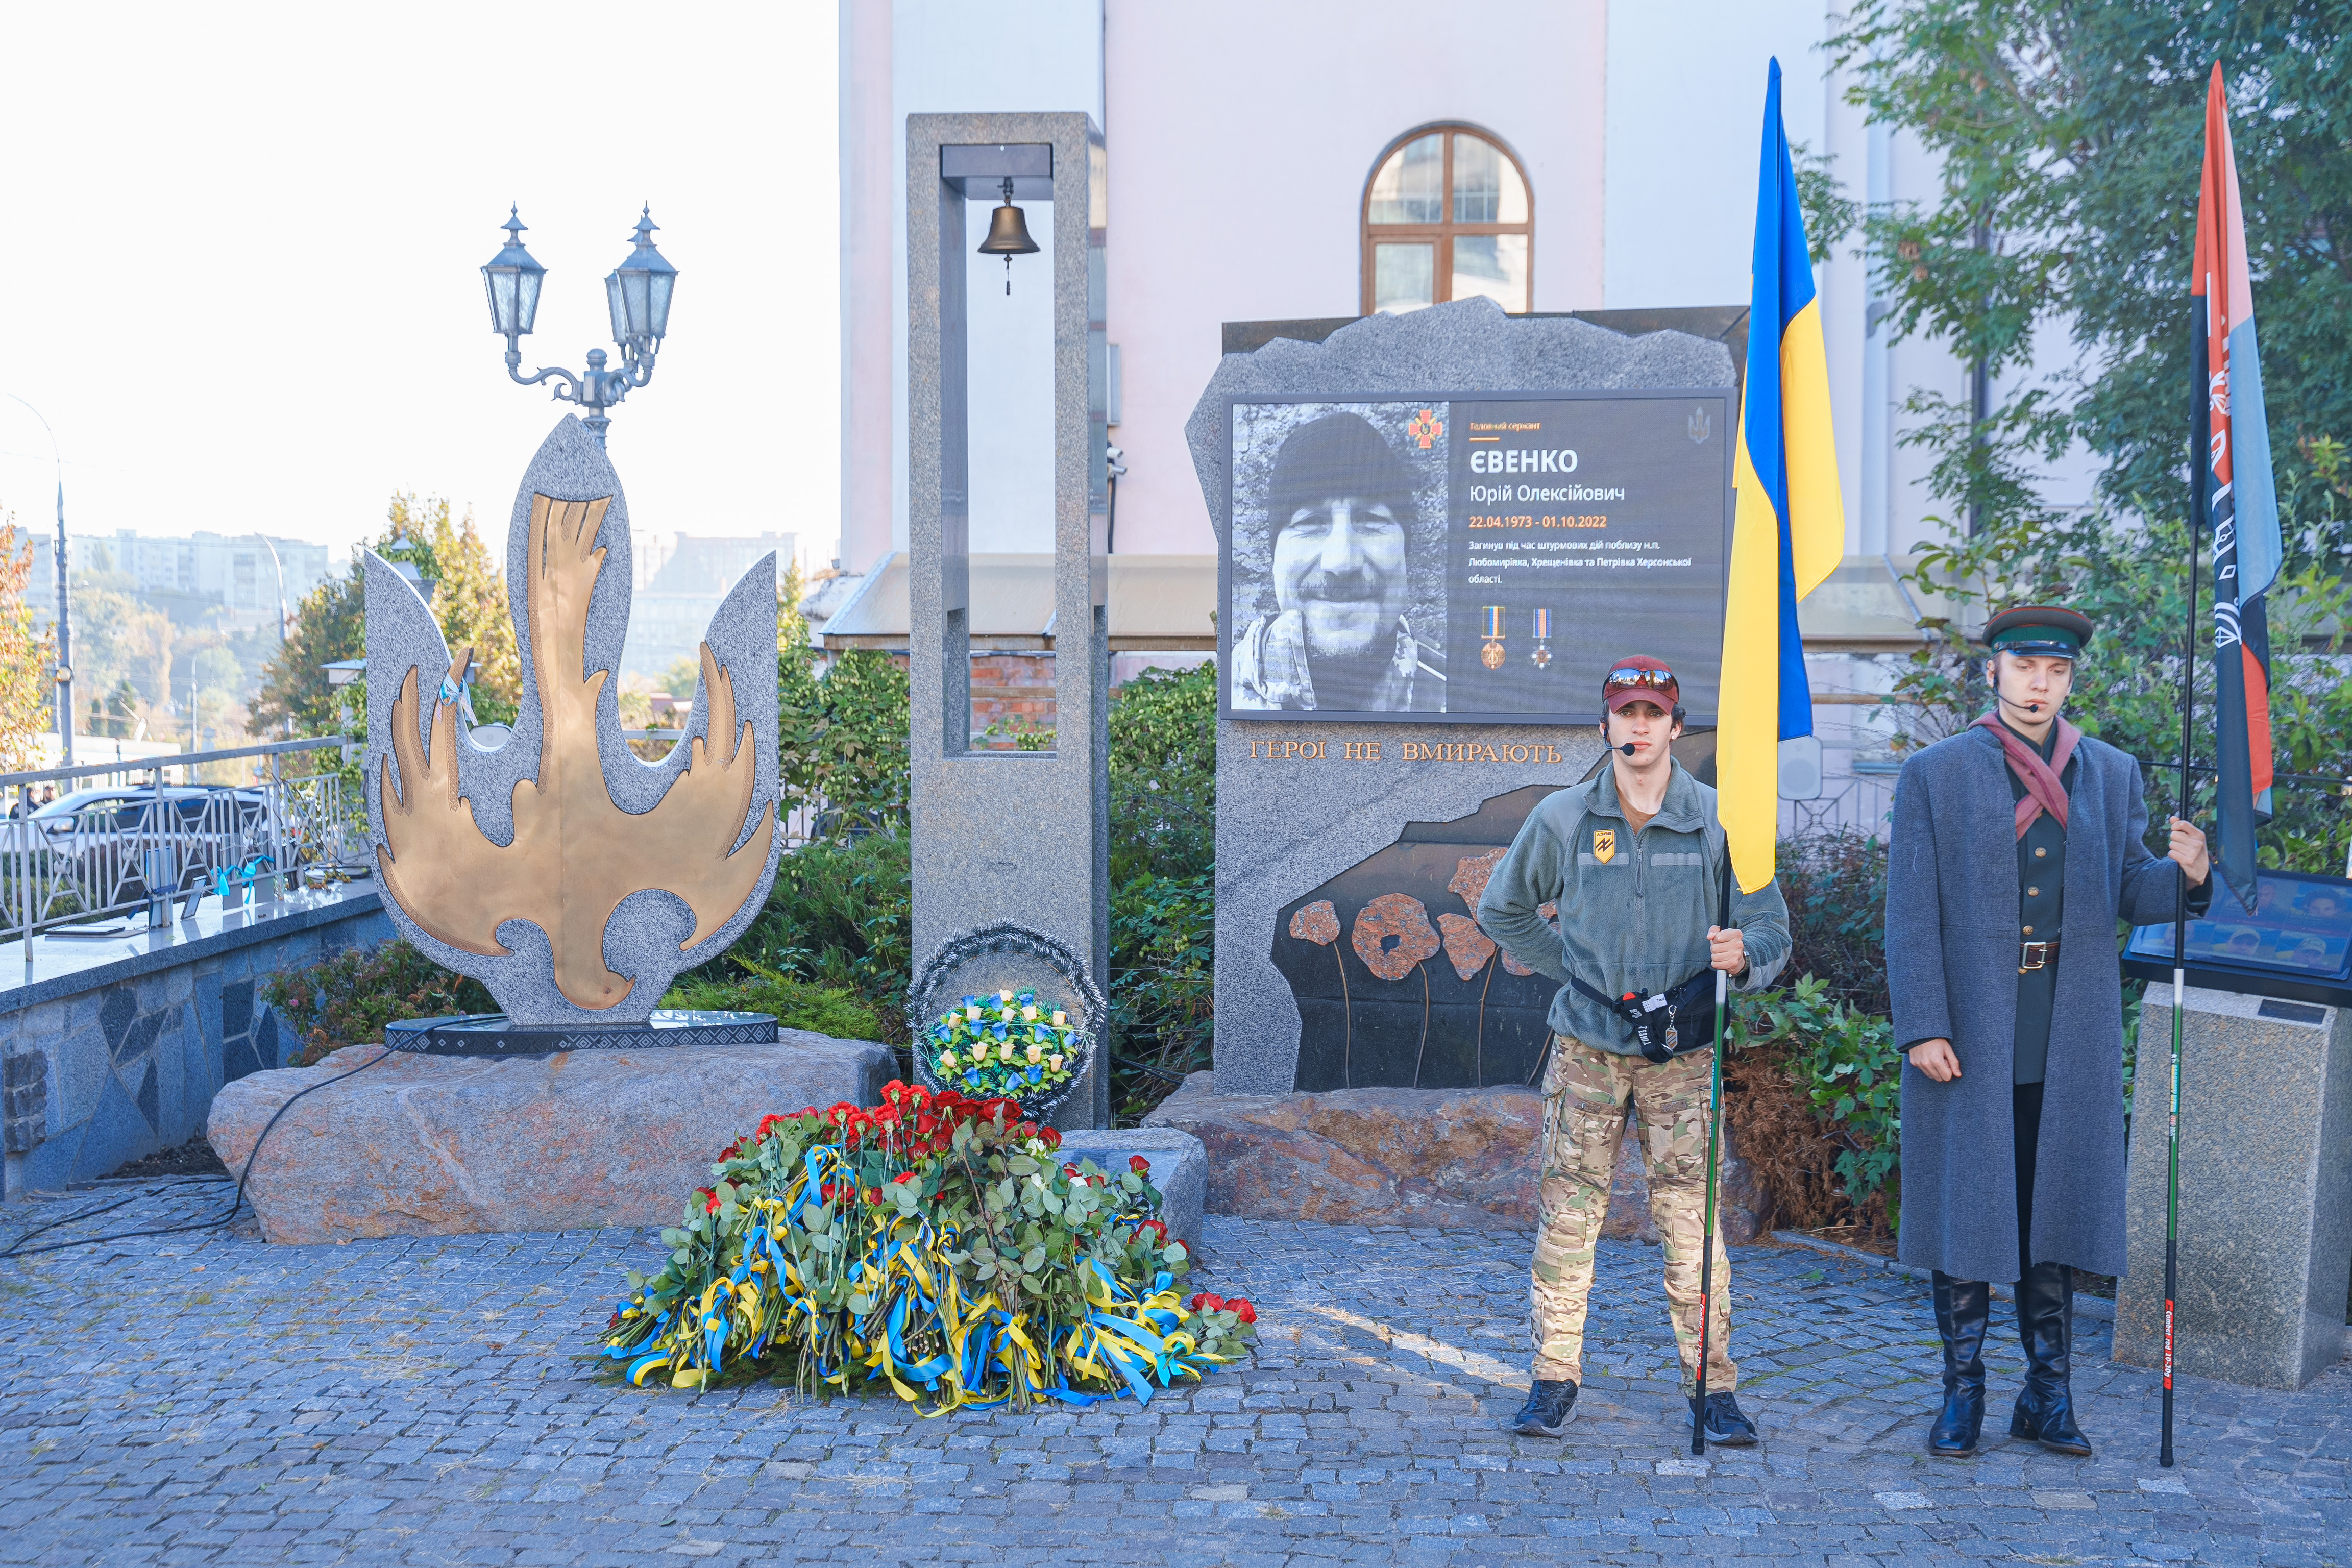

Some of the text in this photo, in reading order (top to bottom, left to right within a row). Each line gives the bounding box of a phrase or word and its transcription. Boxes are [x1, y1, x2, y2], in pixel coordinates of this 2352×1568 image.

[1470, 449, 1578, 473] ЄВЕНКО
[1470, 483, 1625, 506] Юрій Олексійович
[1468, 516, 1533, 528] 22.04.1973
[1542, 515, 1607, 528] 01.10.2022
[1468, 540, 1660, 551] Загинув під час штурмових дій поблизу н.п.
[1468, 557, 1530, 569] Любомирівка,
[1531, 557, 1583, 569] Хрещенівка
[1597, 557, 1635, 569] Петрівка
[1637, 557, 1692, 569] Херсонської
[1468, 574, 1503, 584] області.
[1250, 739, 1562, 764] ГЕРОЇ НЕ ВМИРАЮТЬ
[2164, 1353, 2172, 1378] 10-30g
